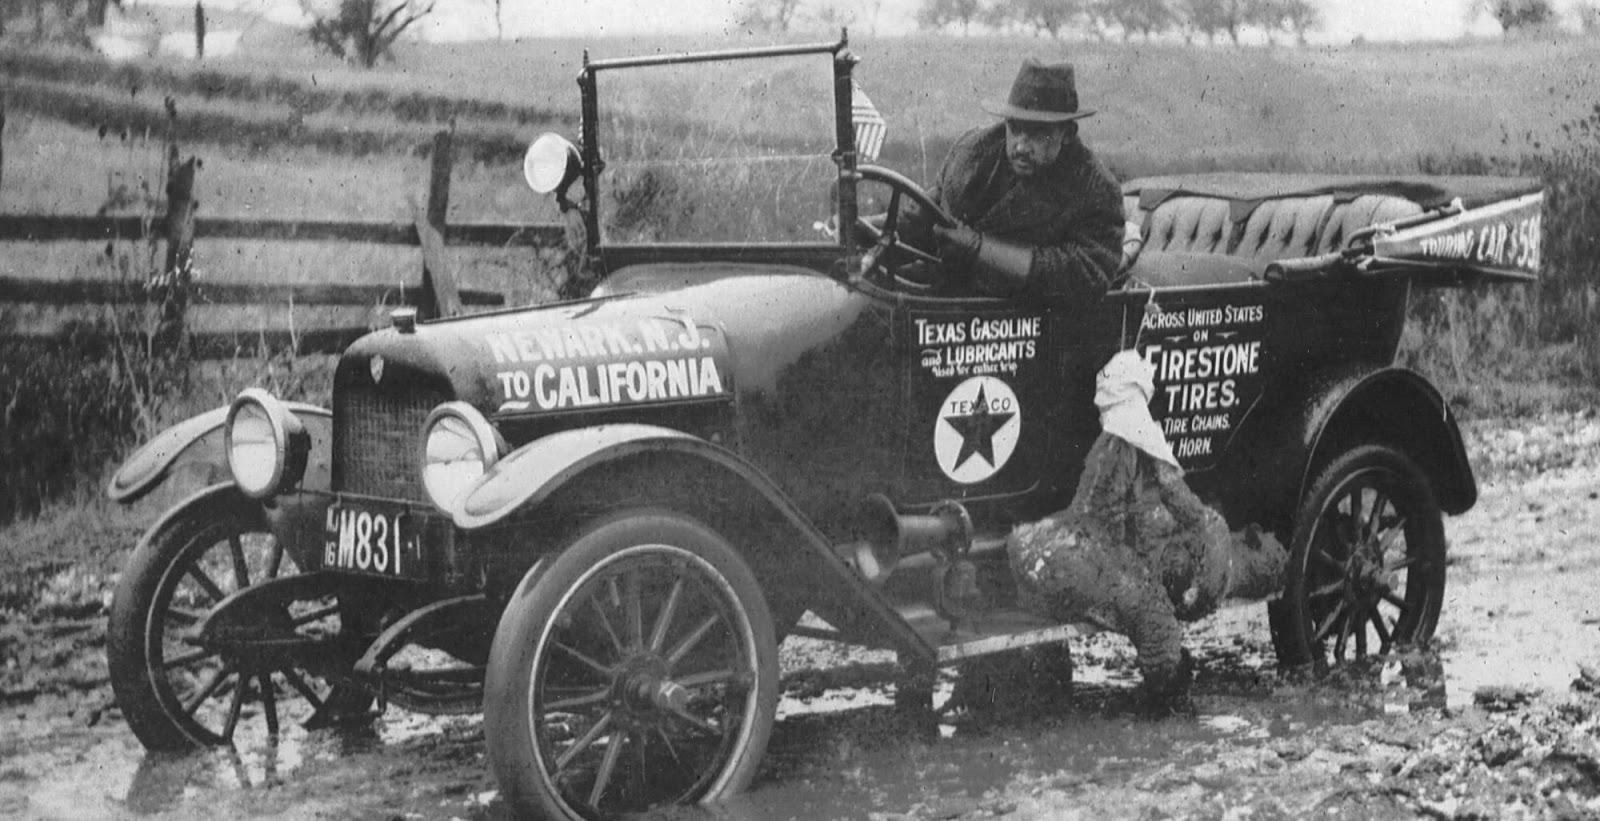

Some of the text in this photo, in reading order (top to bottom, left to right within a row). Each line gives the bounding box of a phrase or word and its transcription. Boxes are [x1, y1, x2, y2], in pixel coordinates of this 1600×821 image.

[1476, 221, 1507, 264] CAR
[1142, 304, 1264, 329] ACROSS UNITED STATES
[915, 317, 1041, 345] TEXAS GASOLINE
[1193, 330, 1208, 343] ON
[946, 340, 1036, 366] LUBRICANTS
[1145, 341, 1261, 381] FIRESTONE
[497, 357, 722, 410] TO CALIFORNIA
[1165, 379, 1240, 413] TIRES.
[951, 397, 1011, 414] TEXACO
[1164, 417, 1189, 435] TIRE
